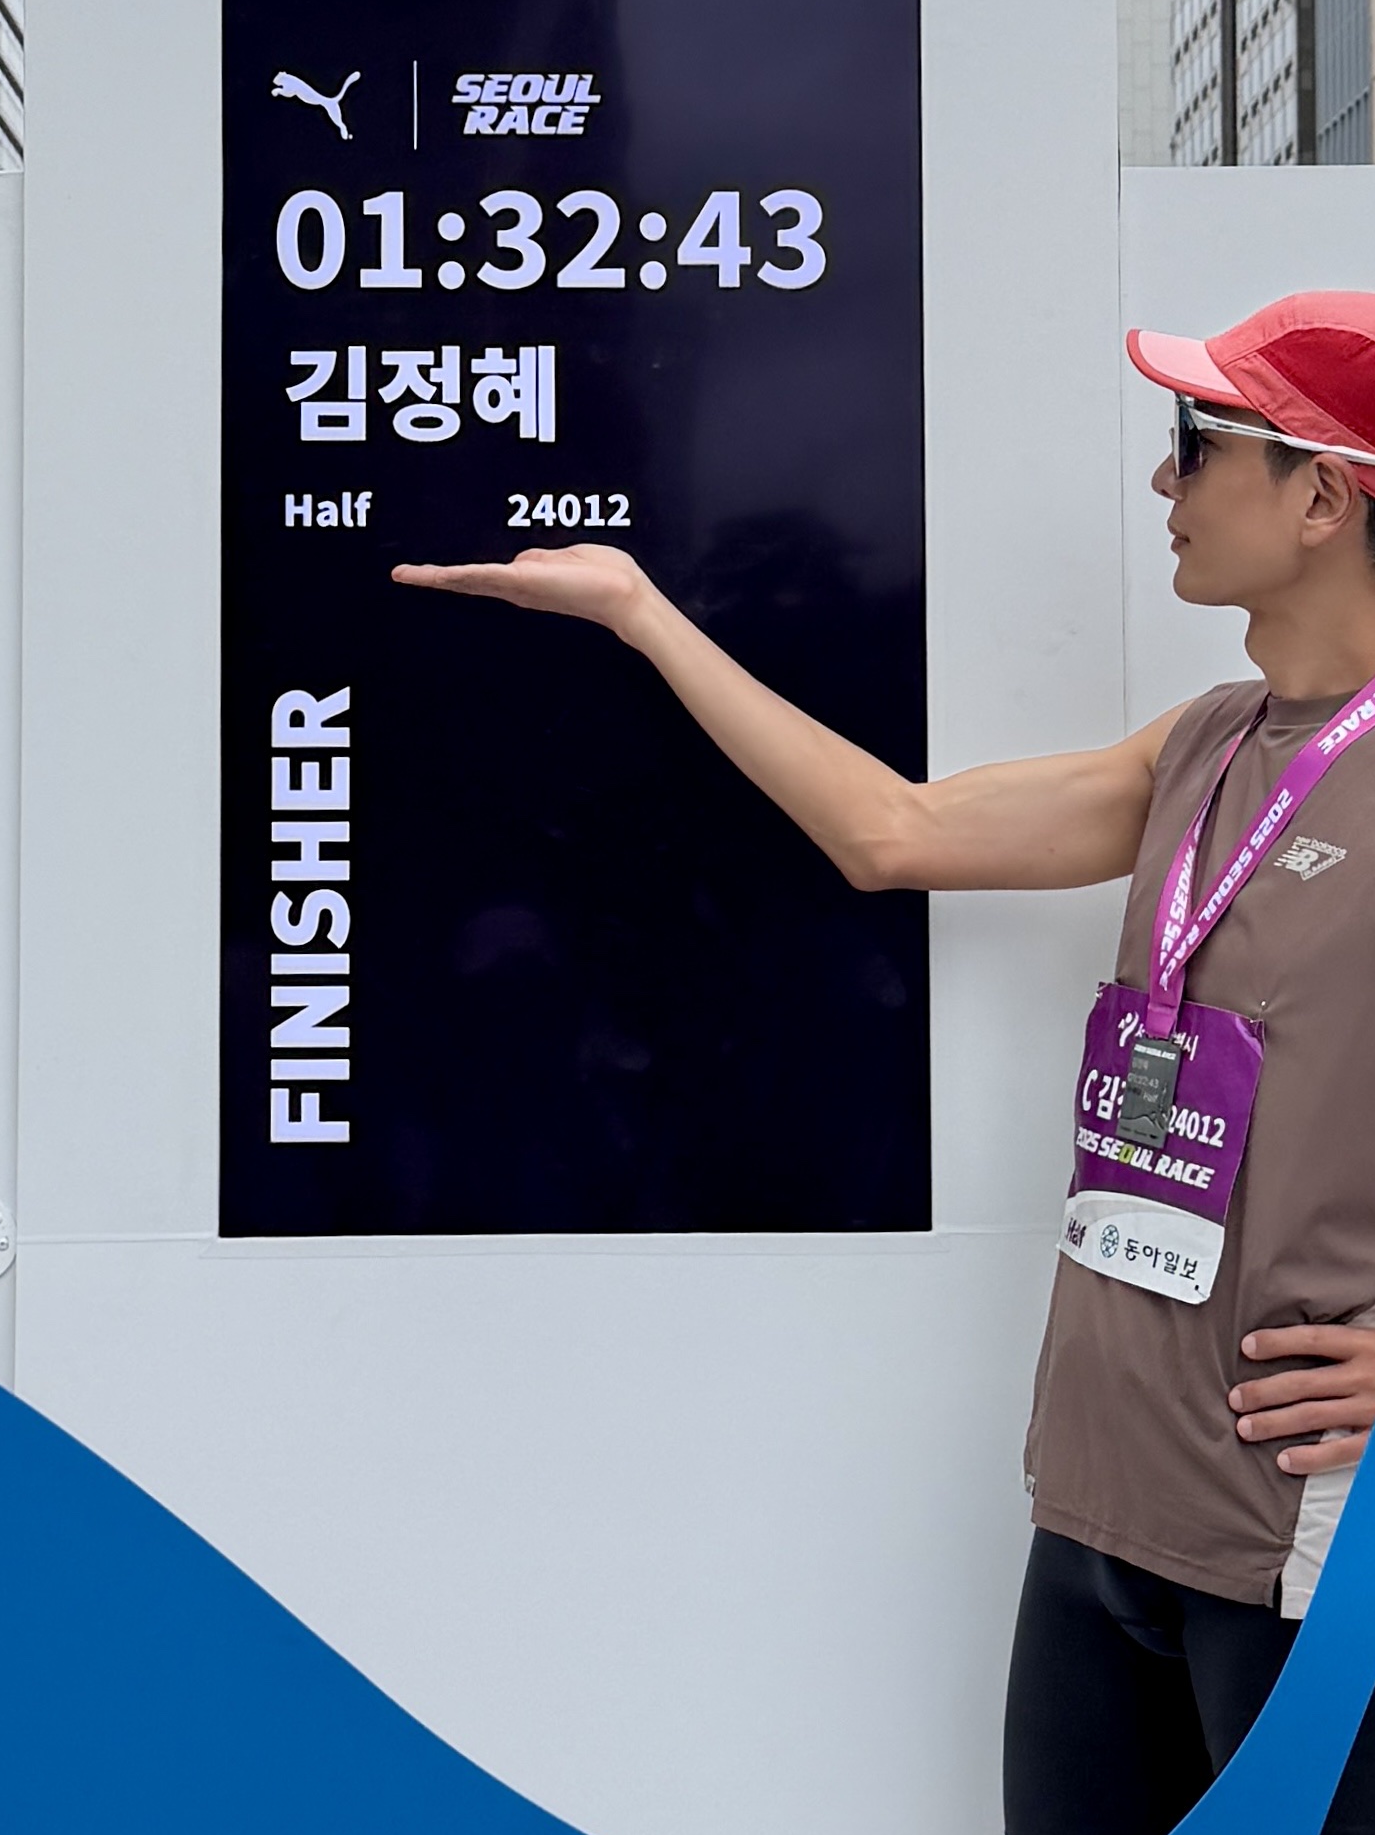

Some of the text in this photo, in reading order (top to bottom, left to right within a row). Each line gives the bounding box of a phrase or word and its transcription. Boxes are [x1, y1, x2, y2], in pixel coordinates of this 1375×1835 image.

[452, 73, 601, 104] SEOUL
[463, 105, 589, 135] RACE
[276, 190, 826, 290] 01:32:43
[285, 345, 556, 443] 김정혜
[284, 492, 631, 527] Half 24012
[1250, 788, 1293, 850] 2025
[271, 686, 350, 1143] FINISHER
[1198, 846, 1253, 921] SEOUL
[1082, 1069, 1098, 1111] C
[1076, 1126, 1215, 1190] 2025 SEOUL RACE
[1124, 1238, 1198, 1280] 동아일보
